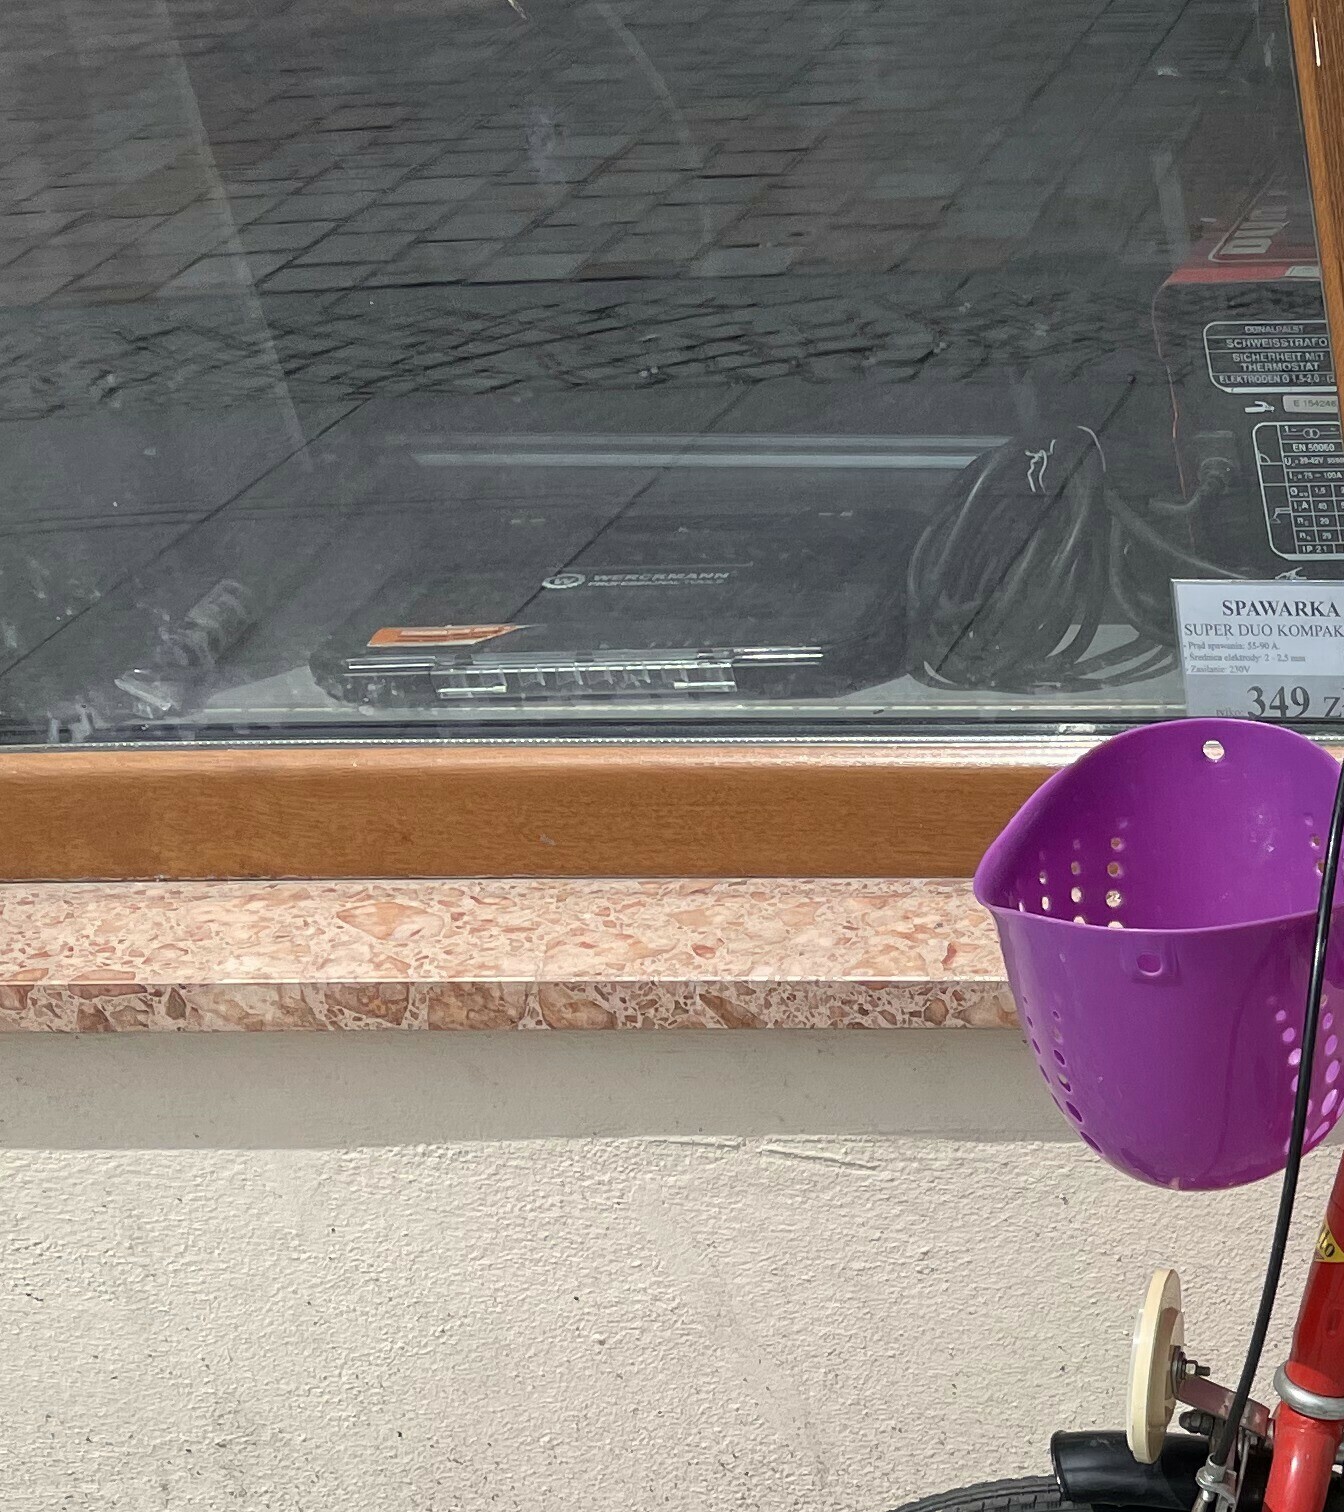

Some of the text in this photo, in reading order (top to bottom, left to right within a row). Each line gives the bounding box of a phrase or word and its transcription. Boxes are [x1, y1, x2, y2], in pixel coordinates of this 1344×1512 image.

[1226, 338, 1328, 348] SCHWEISSTRAFO
[1232, 352, 1325, 362] SICHERHEIT MIT
[1240, 362, 1320, 372] THERMOSTAT
[1219, 375, 1280, 384] ELEKTRODEN
[1293, 443, 1306, 452] EN
[594, 573, 730, 581] WERCKMANN
[1222, 600, 1341, 617] SPAWARKA
[1184, 623, 1234, 637] SUPER
[1238, 624, 1273, 637] DUO
[1247, 642, 1270, 650] 55-90
[1229, 665, 1250, 673] 230V
[1247, 686, 1310, 718] 349
